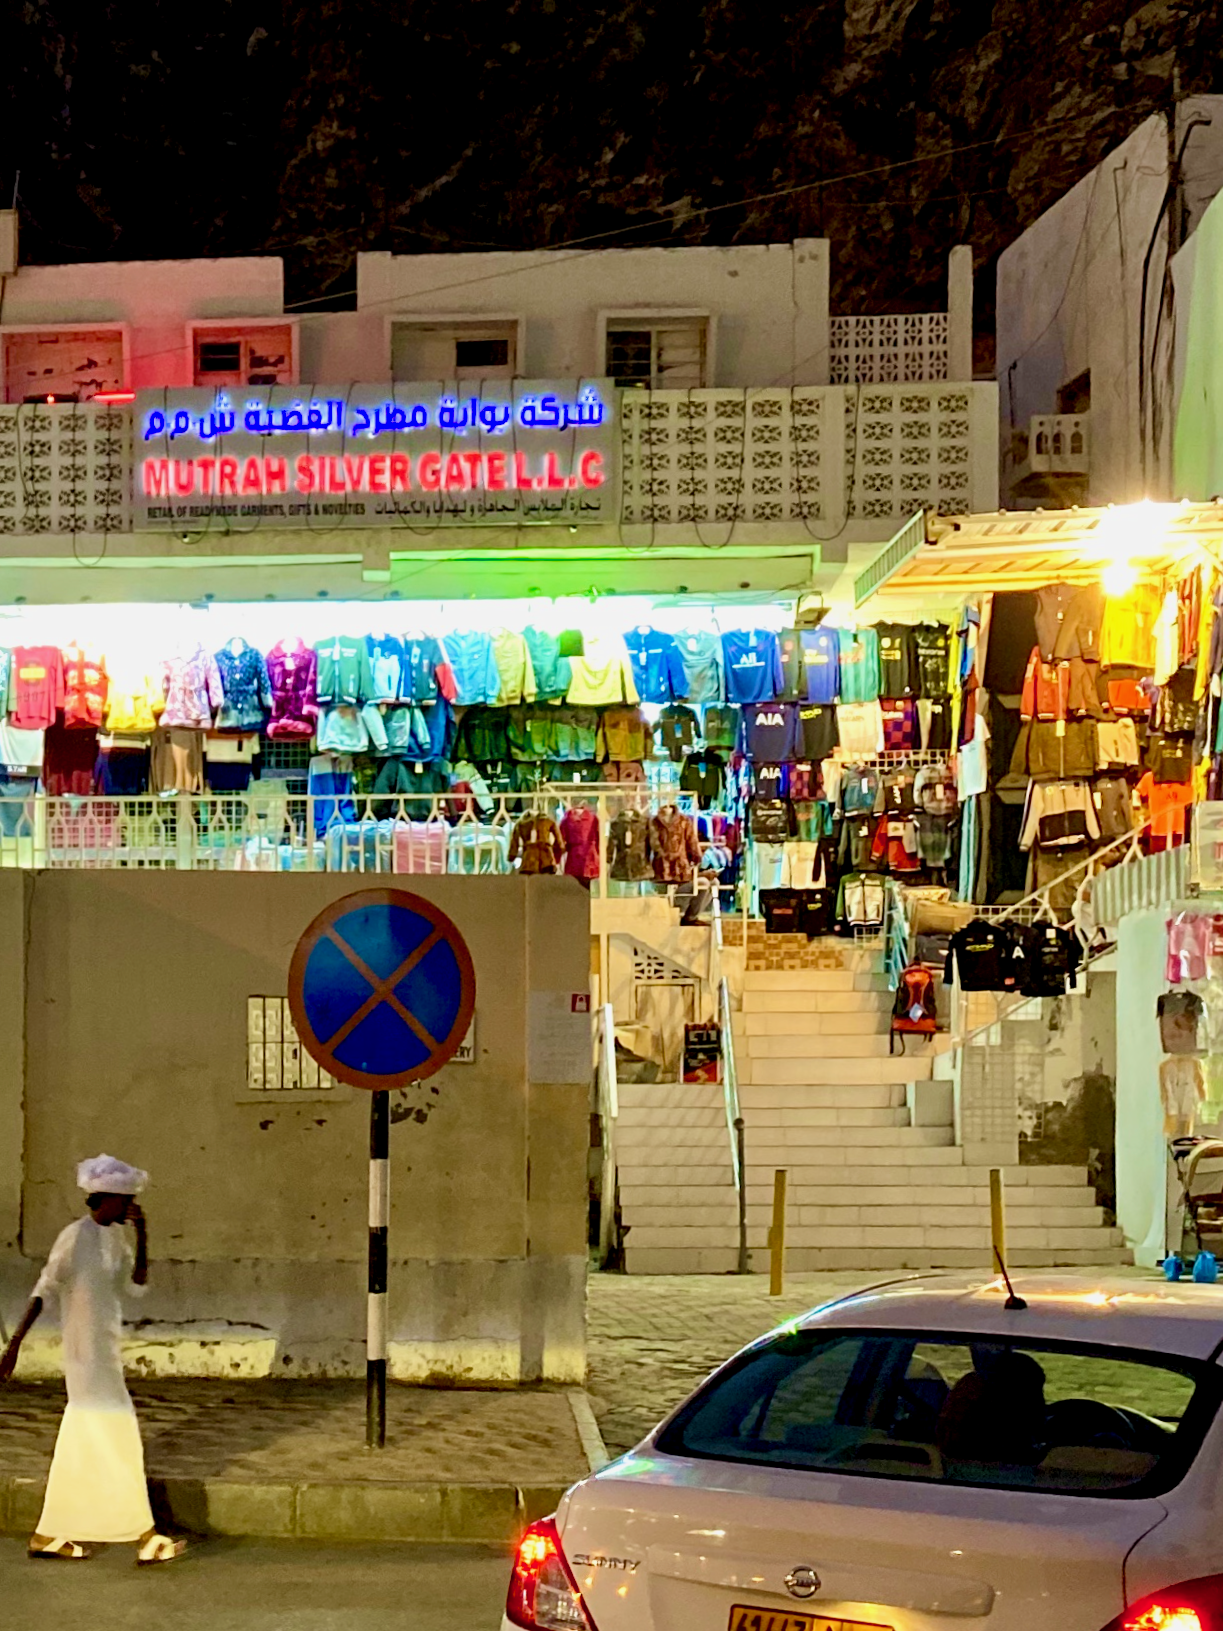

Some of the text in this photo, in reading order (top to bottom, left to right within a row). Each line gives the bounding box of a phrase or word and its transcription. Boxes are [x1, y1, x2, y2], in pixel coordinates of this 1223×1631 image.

[351, 403, 427, 437] مطرح
[439, 396, 509, 435] بوابة
[521, 387, 603, 432] شركة
[143, 450, 605, 496] MUTRAH SILVER GATE L.L.C
[176, 505, 187, 517] OF
[288, 503, 311, 516] GIFTS
[314, 503, 319, 516] &
[322, 503, 366, 516] NOVELTIES
[755, 712, 784, 726] AIA
